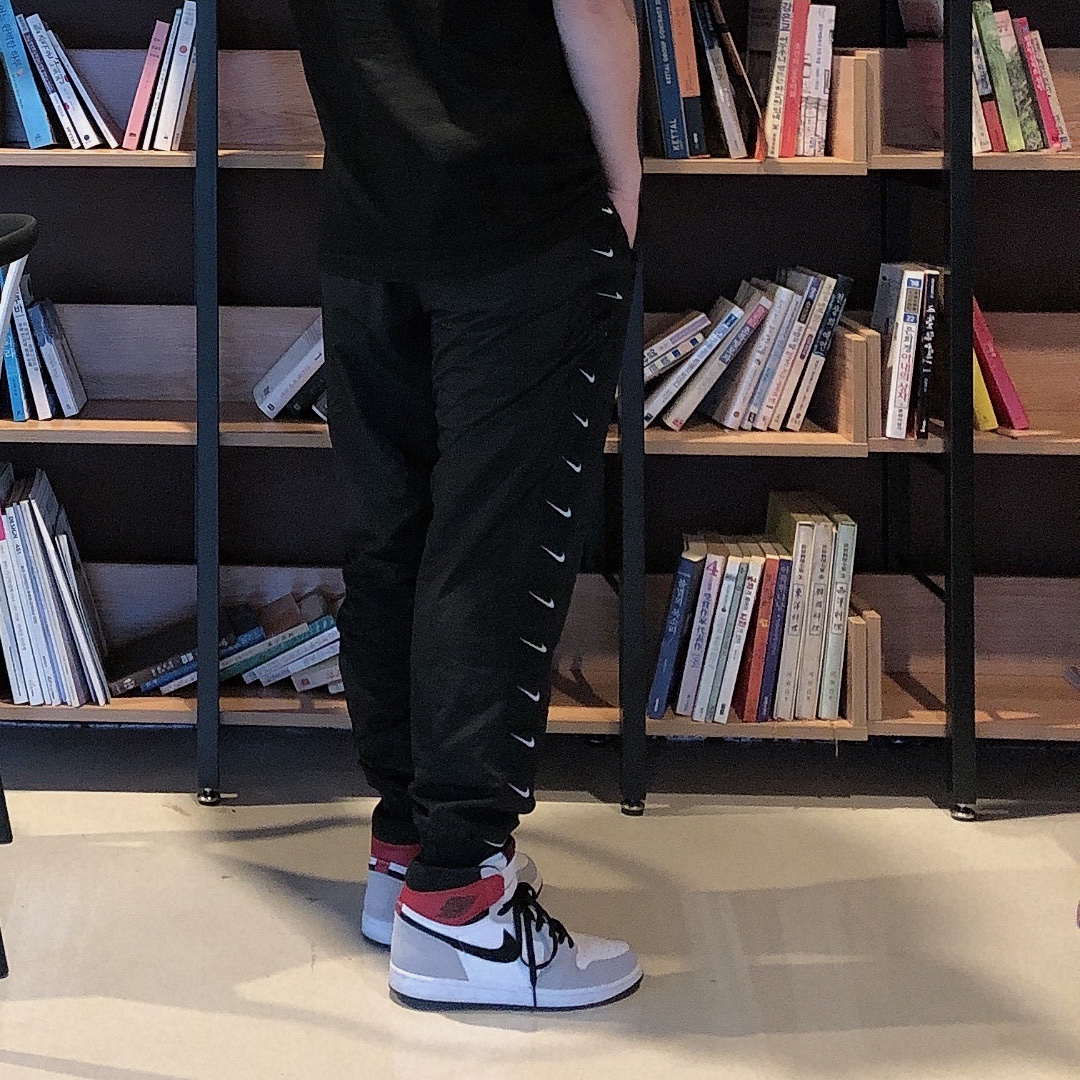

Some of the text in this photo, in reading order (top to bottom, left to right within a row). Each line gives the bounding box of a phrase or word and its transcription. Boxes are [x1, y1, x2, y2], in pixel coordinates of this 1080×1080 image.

[0, 22, 17, 49] 완벽한
[9, 49, 22, 68] 하루
[669, 118, 683, 151] KETTAL
[900, 353, 911, 382] 아내의
[706, 560, 720, 576] 4
